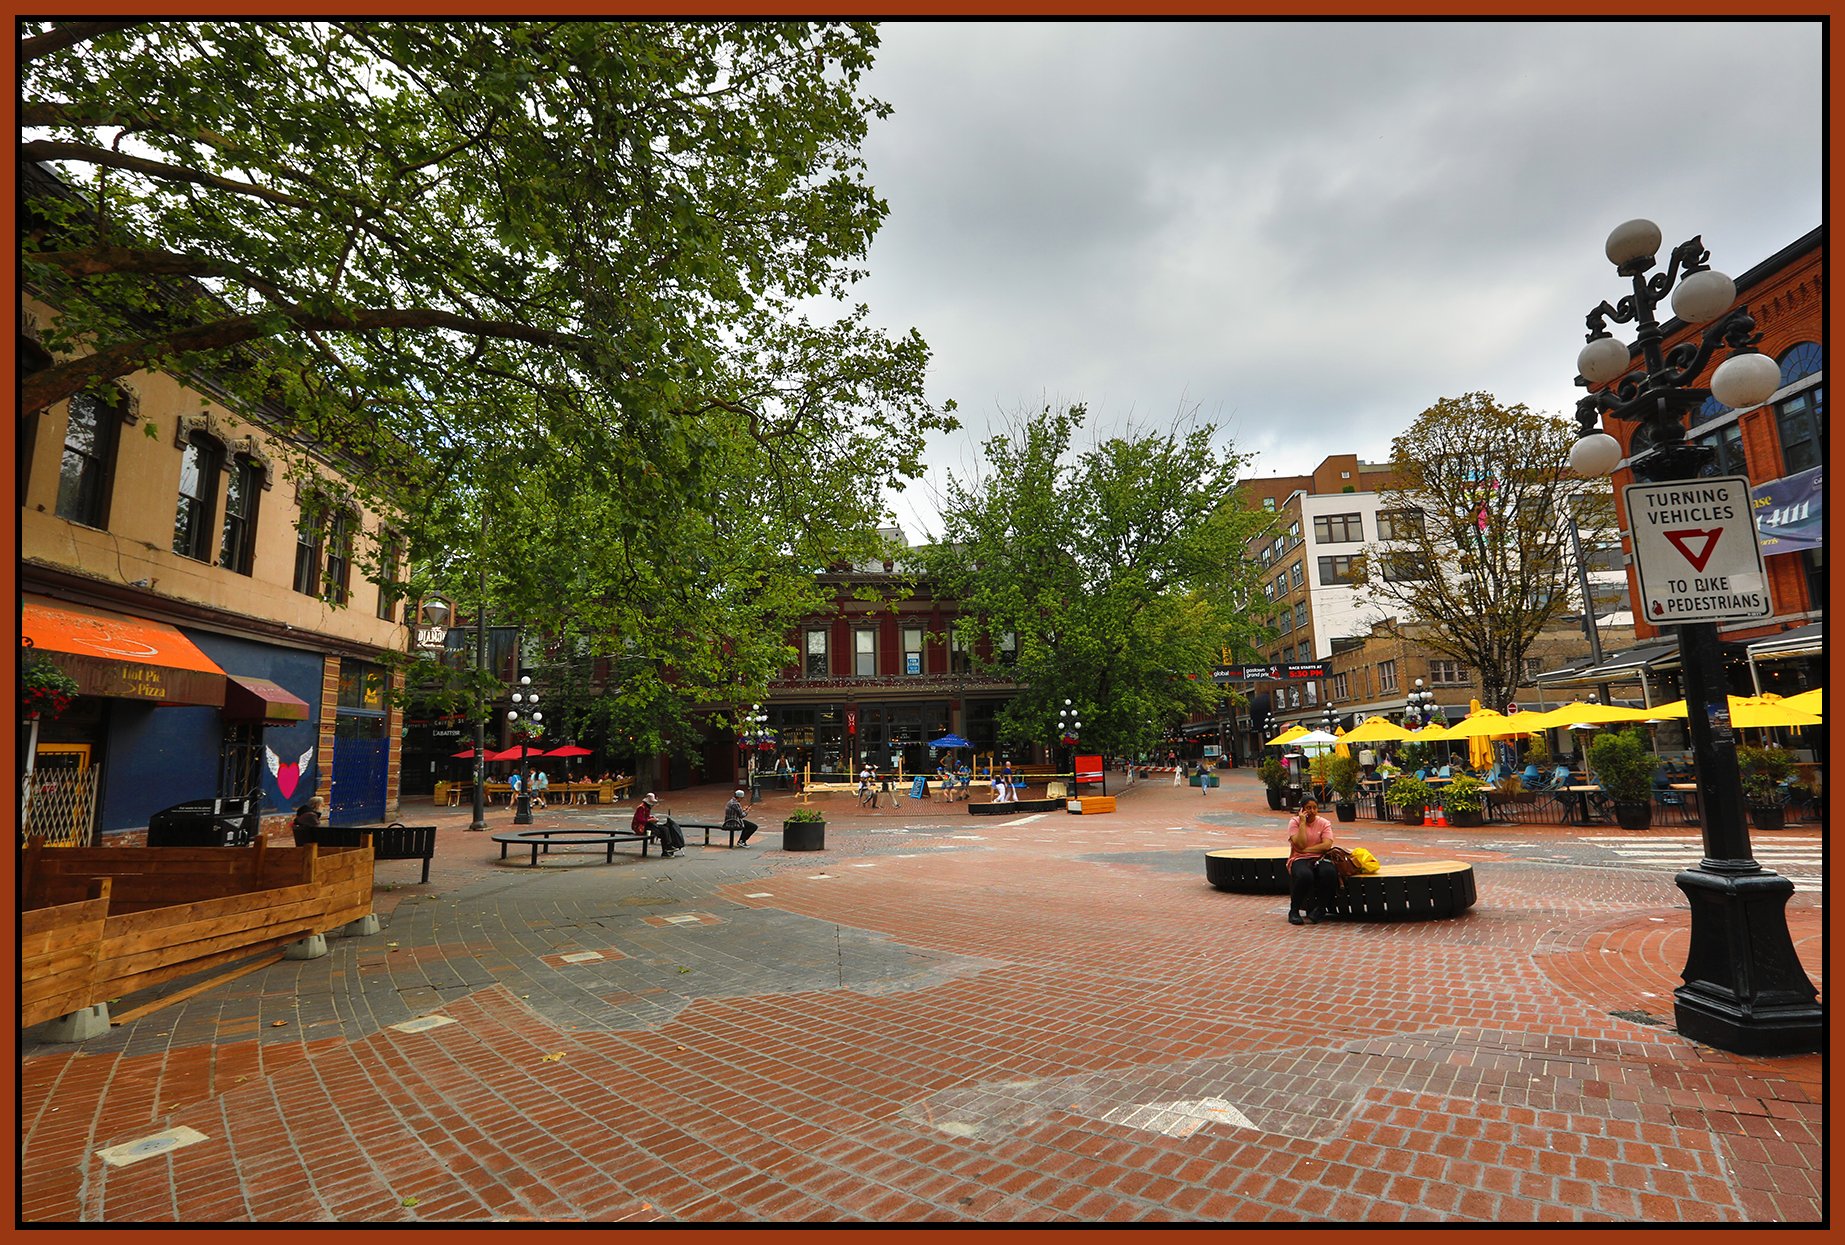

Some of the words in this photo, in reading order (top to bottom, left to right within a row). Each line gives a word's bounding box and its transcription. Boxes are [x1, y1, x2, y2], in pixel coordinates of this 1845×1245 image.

[1645, 488, 1729, 507] TURNING
[1753, 495, 1772, 509] ase
[1647, 506, 1734, 525] VEHICLES
[1766, 499, 1810, 529] 4111
[1668, 580, 1687, 594] TO
[1694, 577, 1729, 592] BIKE
[1667, 594, 1760, 612] PEDESTRIANS
[1213, 670, 1230, 678] global
[1289, 670, 1308, 678] 5:30
[137, 683, 166, 697] Pizza
